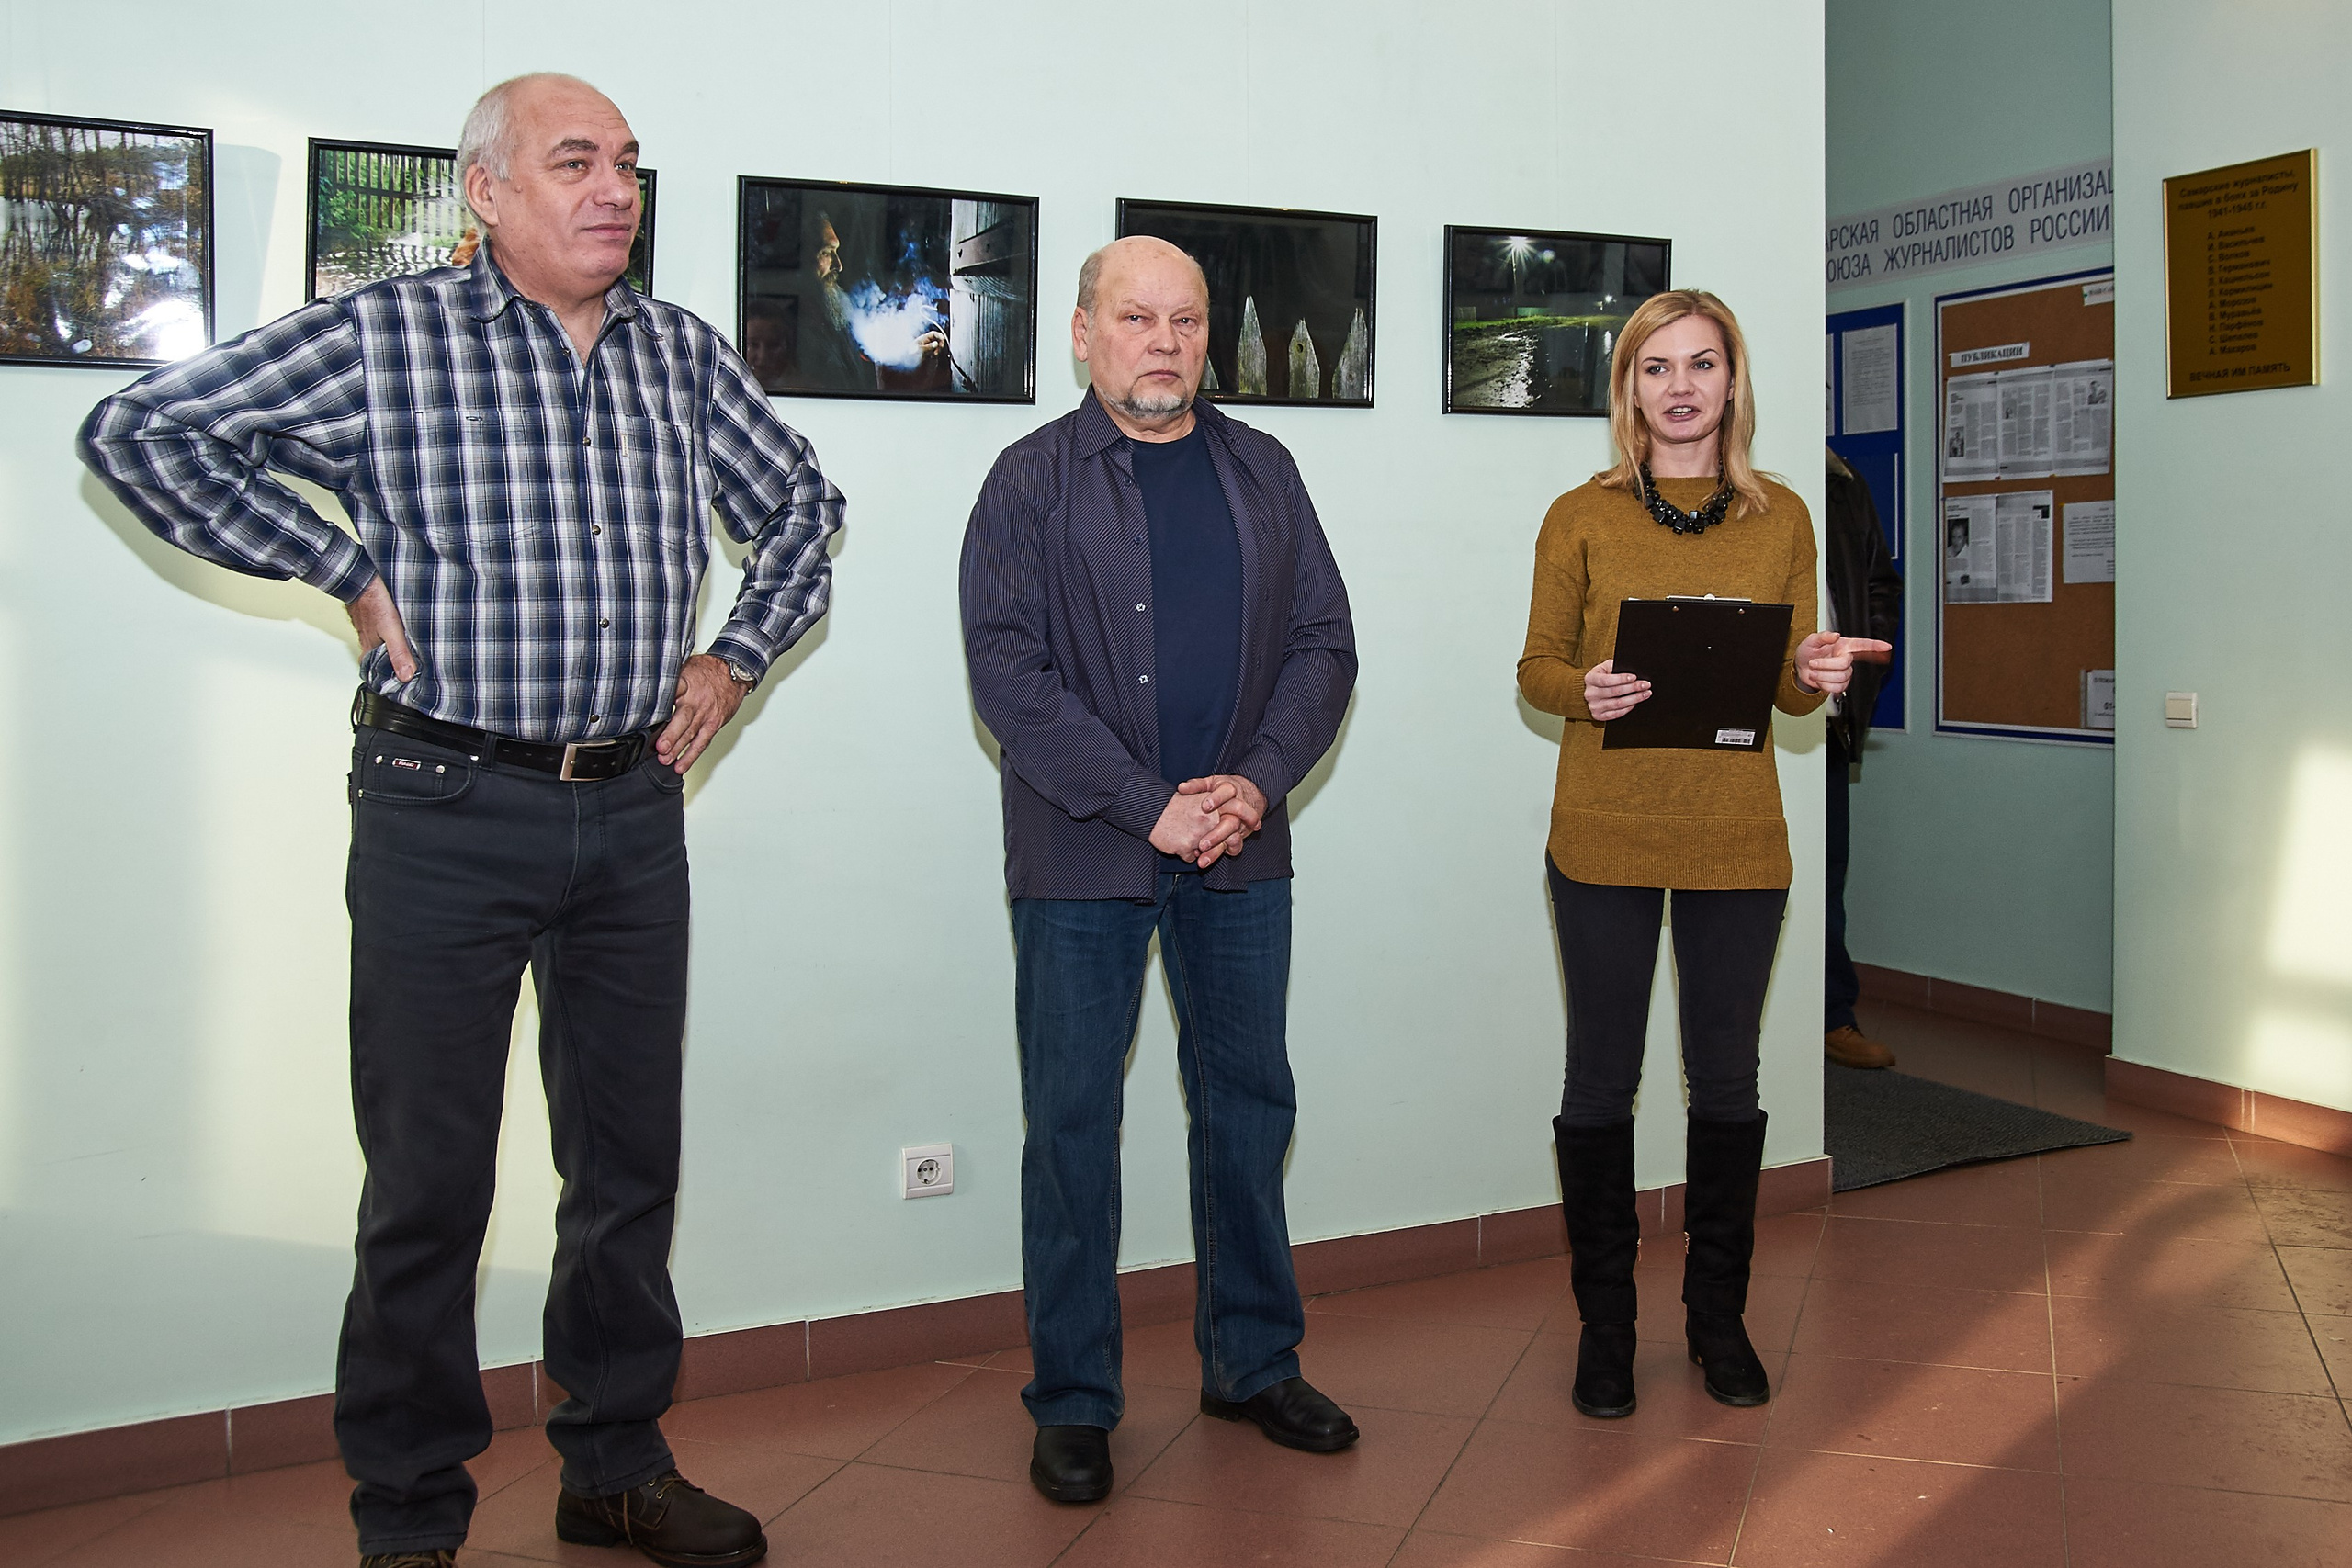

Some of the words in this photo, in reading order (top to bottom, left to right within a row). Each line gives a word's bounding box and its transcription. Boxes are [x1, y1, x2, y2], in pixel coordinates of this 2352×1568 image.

[2179, 182, 2230, 198] Самарские
[2223, 191, 2246, 202] боях
[2249, 189, 2259, 198] за
[2261, 181, 2299, 196] Родину
[1893, 195, 1993, 239] ОБЛАСТНАЯ
[2207, 201, 2253, 219] 1941-1945
[1826, 253, 1871, 283] ОЮЗА
[1883, 224, 2015, 273] ЖУРНАЛИСТОВ
[2030, 204, 2109, 244] РОССИИ
[1961, 345, 2024, 364] ПУБЛИКАЦИИ
[2189, 368, 2229, 382] ВЕЧНАЯ
[2231, 367, 2246, 378] ИМ
[2248, 361, 2290, 376] ПАМЯТЬ
